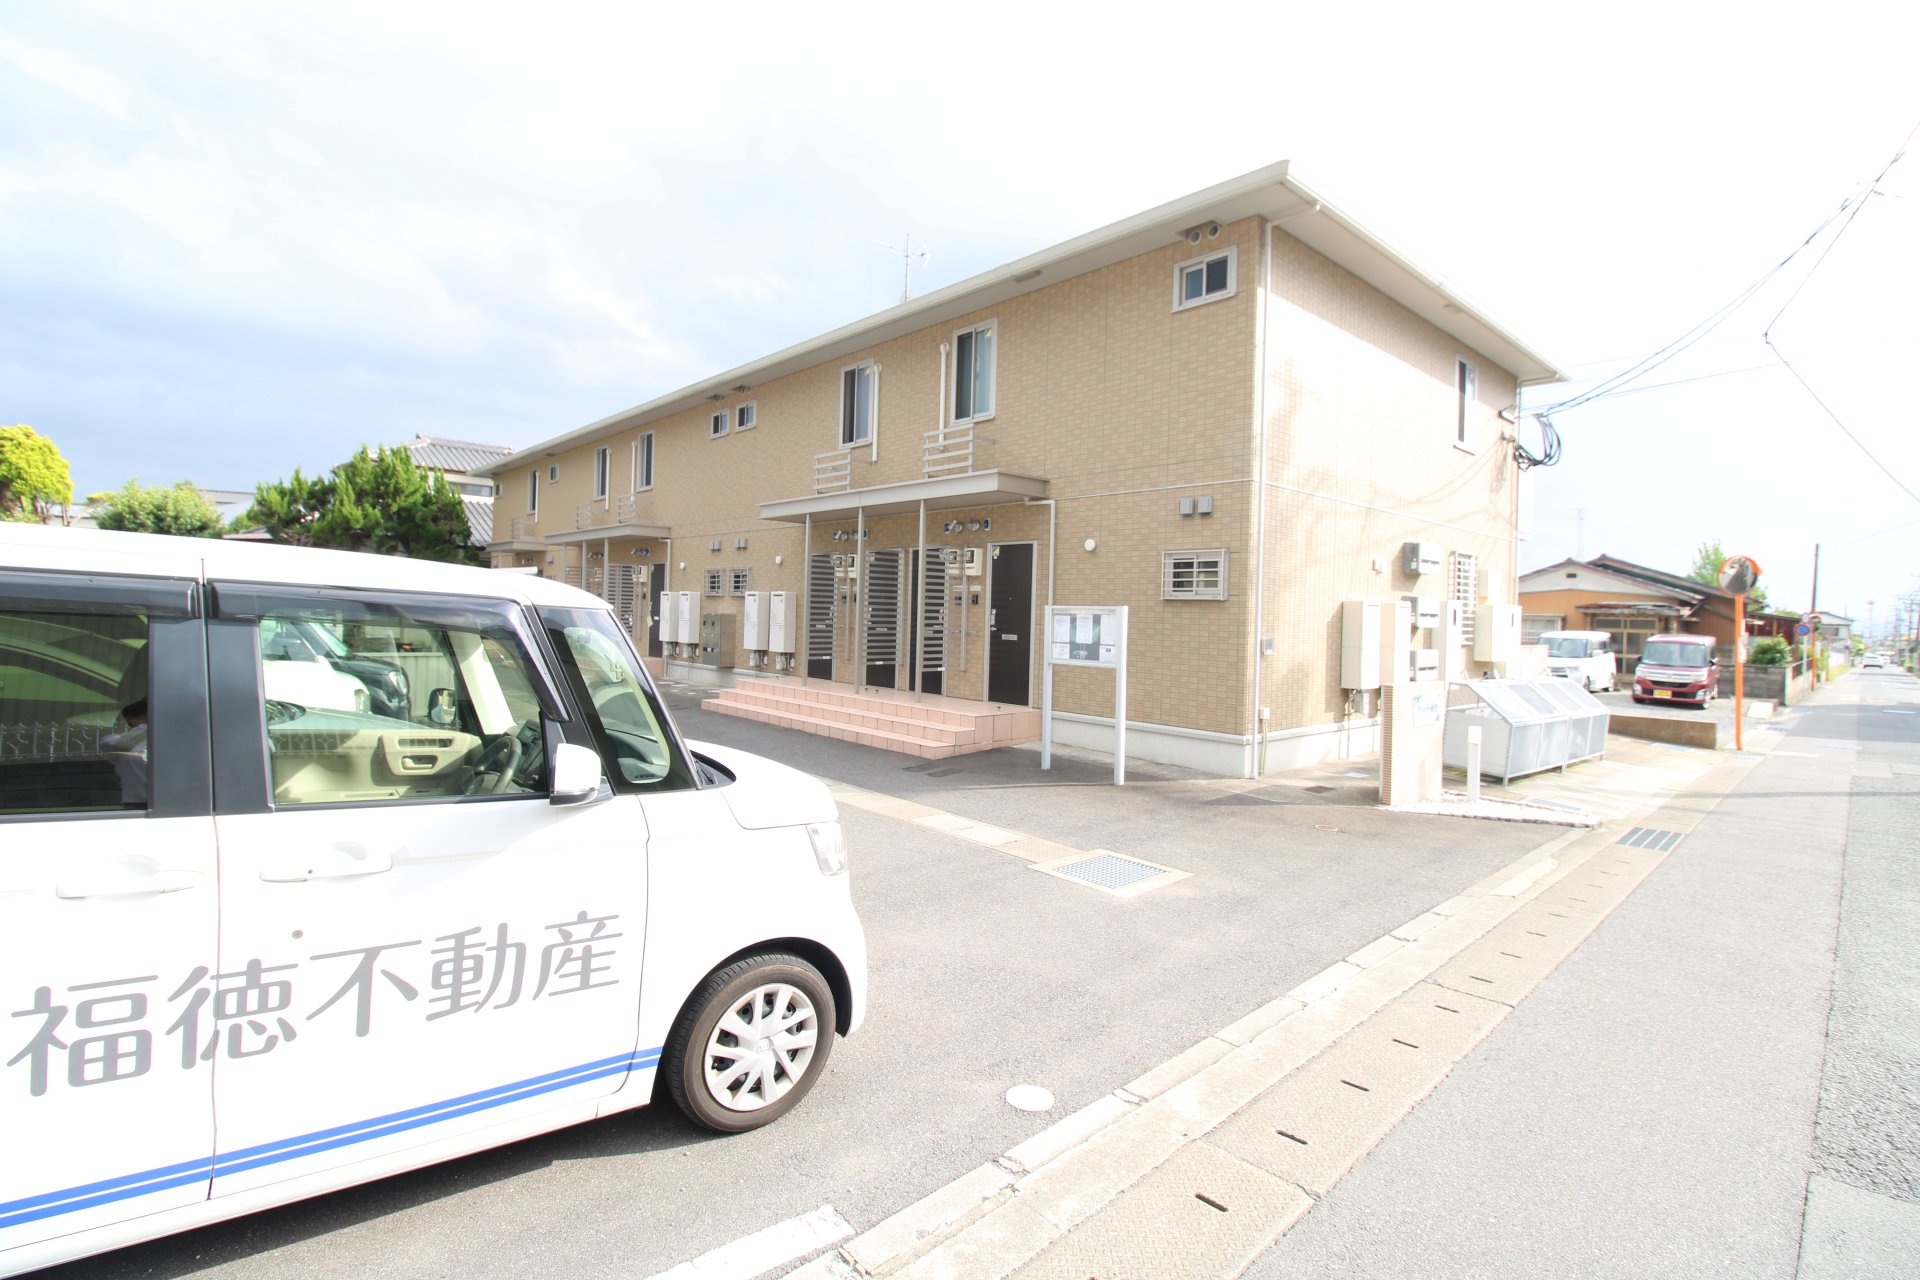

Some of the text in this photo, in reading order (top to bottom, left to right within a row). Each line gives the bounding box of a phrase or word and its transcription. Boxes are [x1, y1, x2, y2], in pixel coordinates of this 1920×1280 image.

[7, 910, 624, 1097] 福徳不動産
